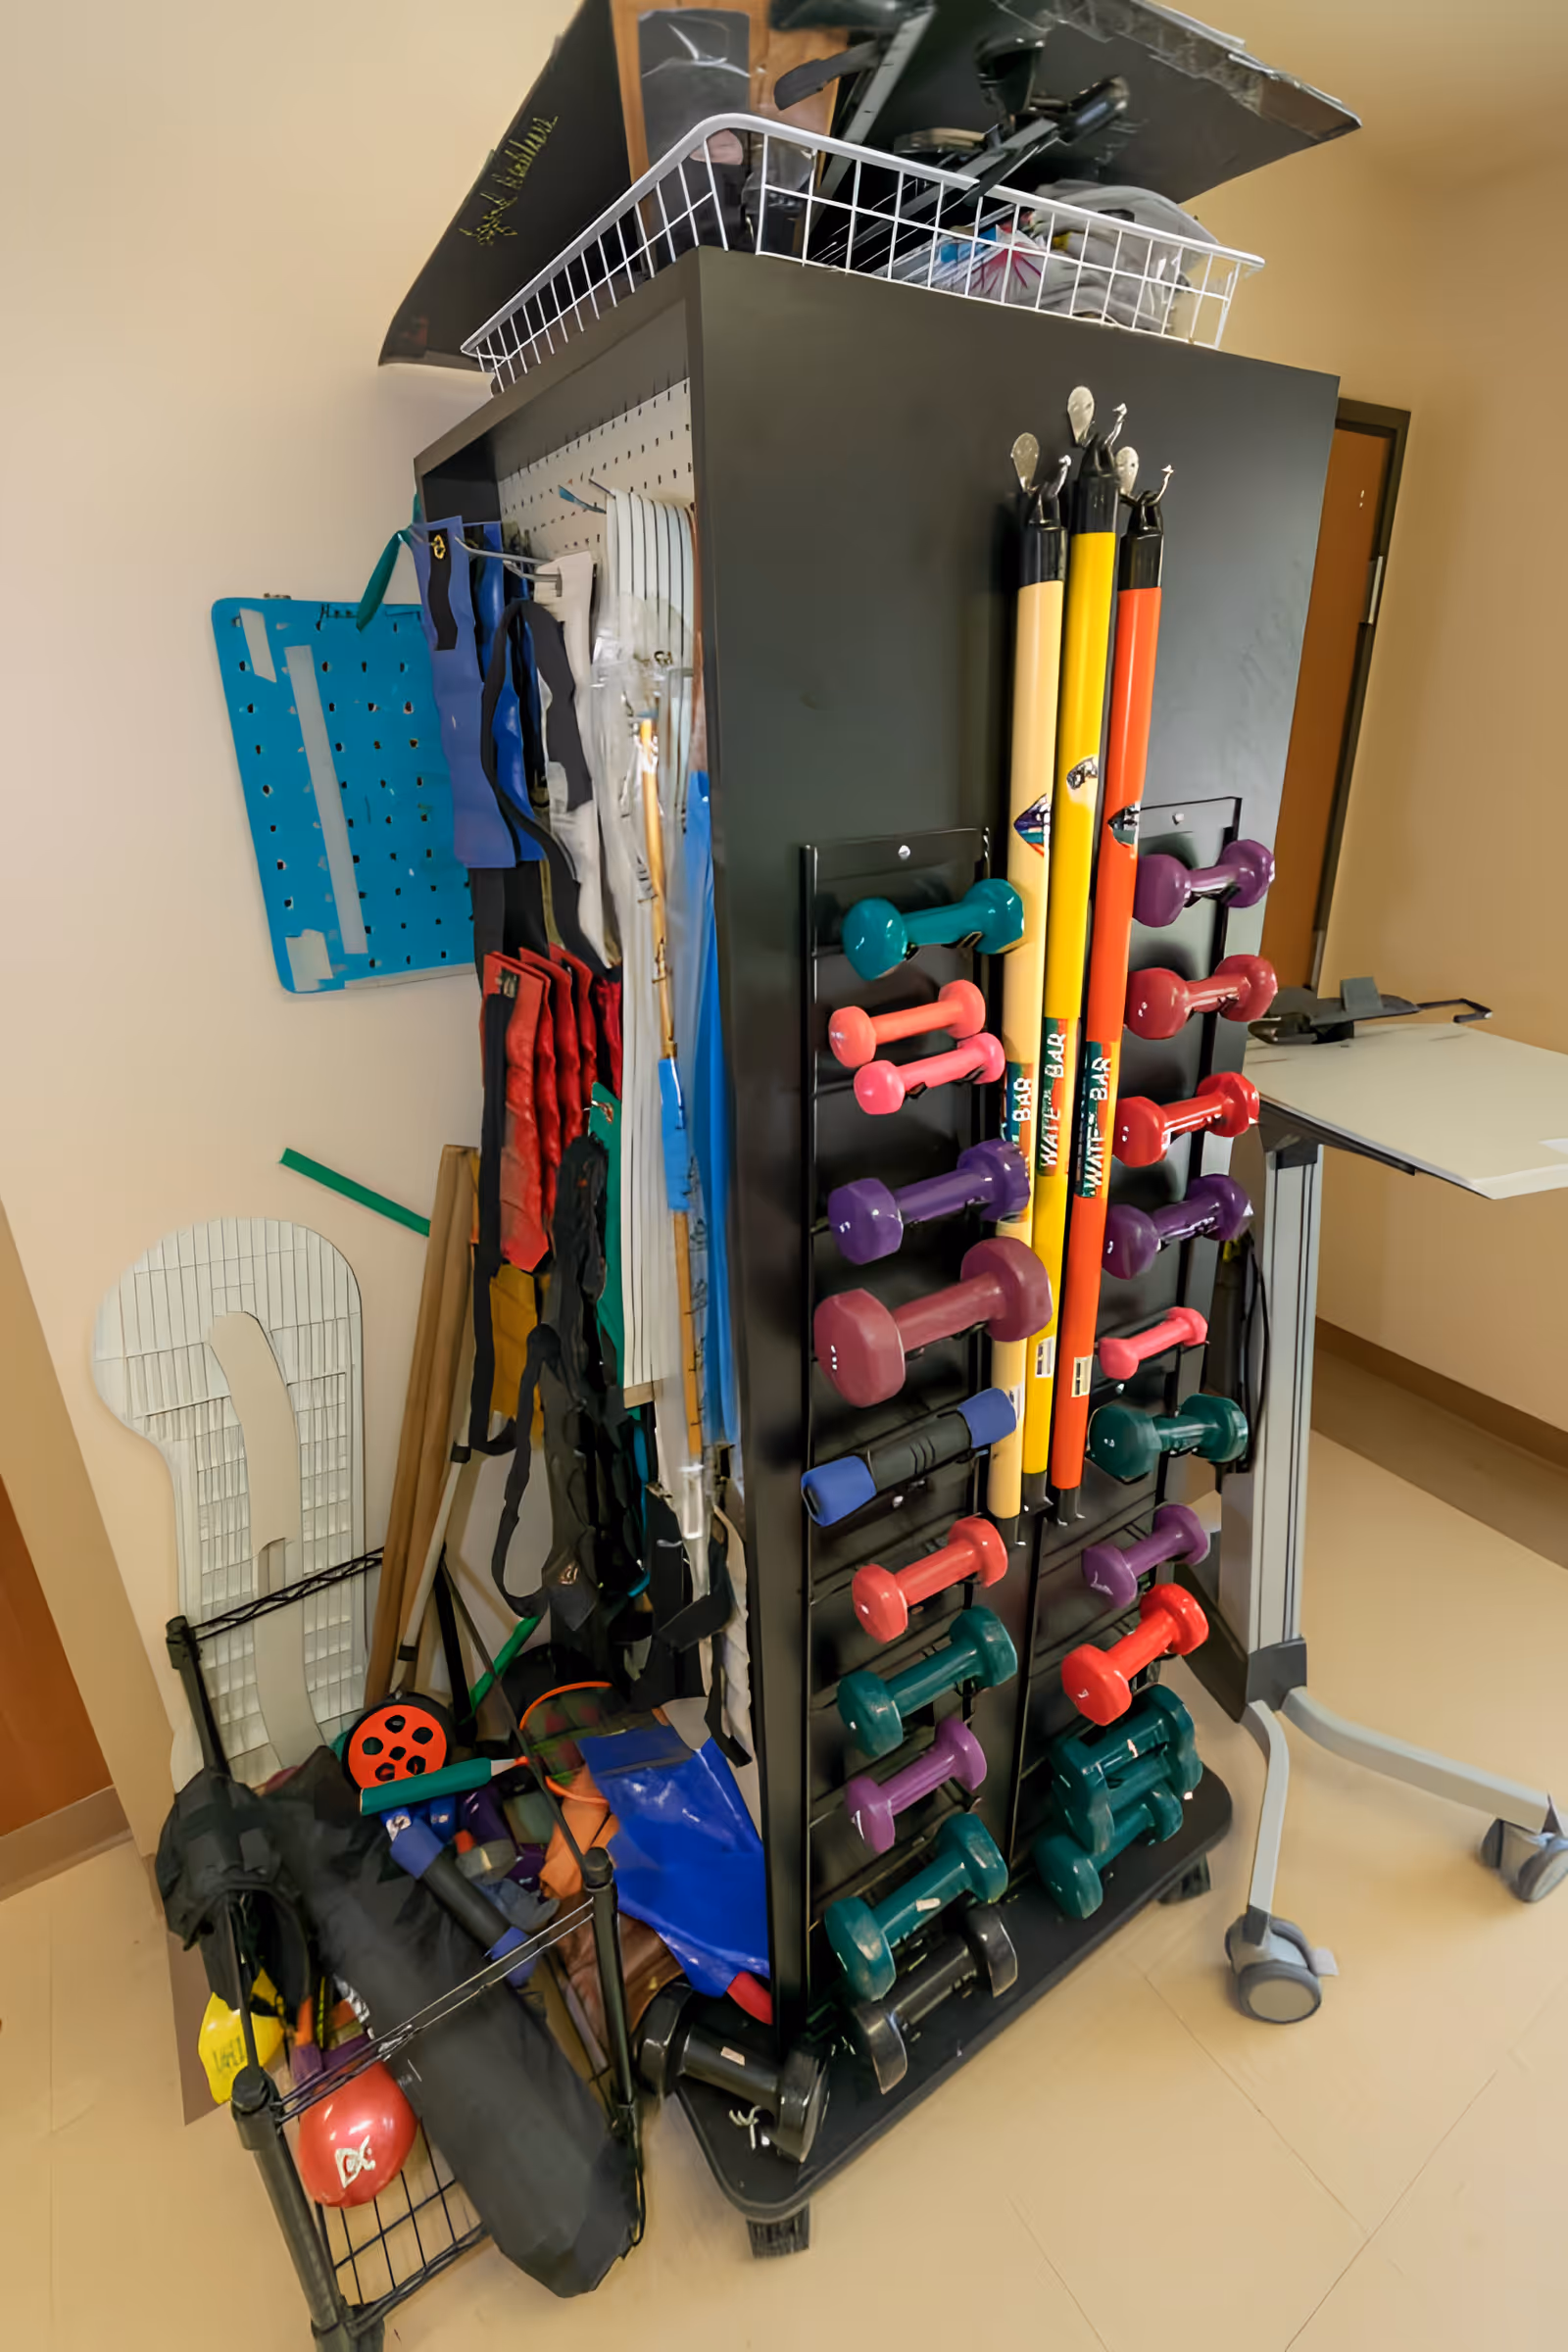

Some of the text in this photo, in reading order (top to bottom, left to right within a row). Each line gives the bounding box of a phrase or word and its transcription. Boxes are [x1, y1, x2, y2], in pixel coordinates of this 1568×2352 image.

[1045, 1033, 1066, 1078] BAR
[1011, 1077, 1032, 1122] BAR
[1090, 1056, 1111, 1101] BAR
